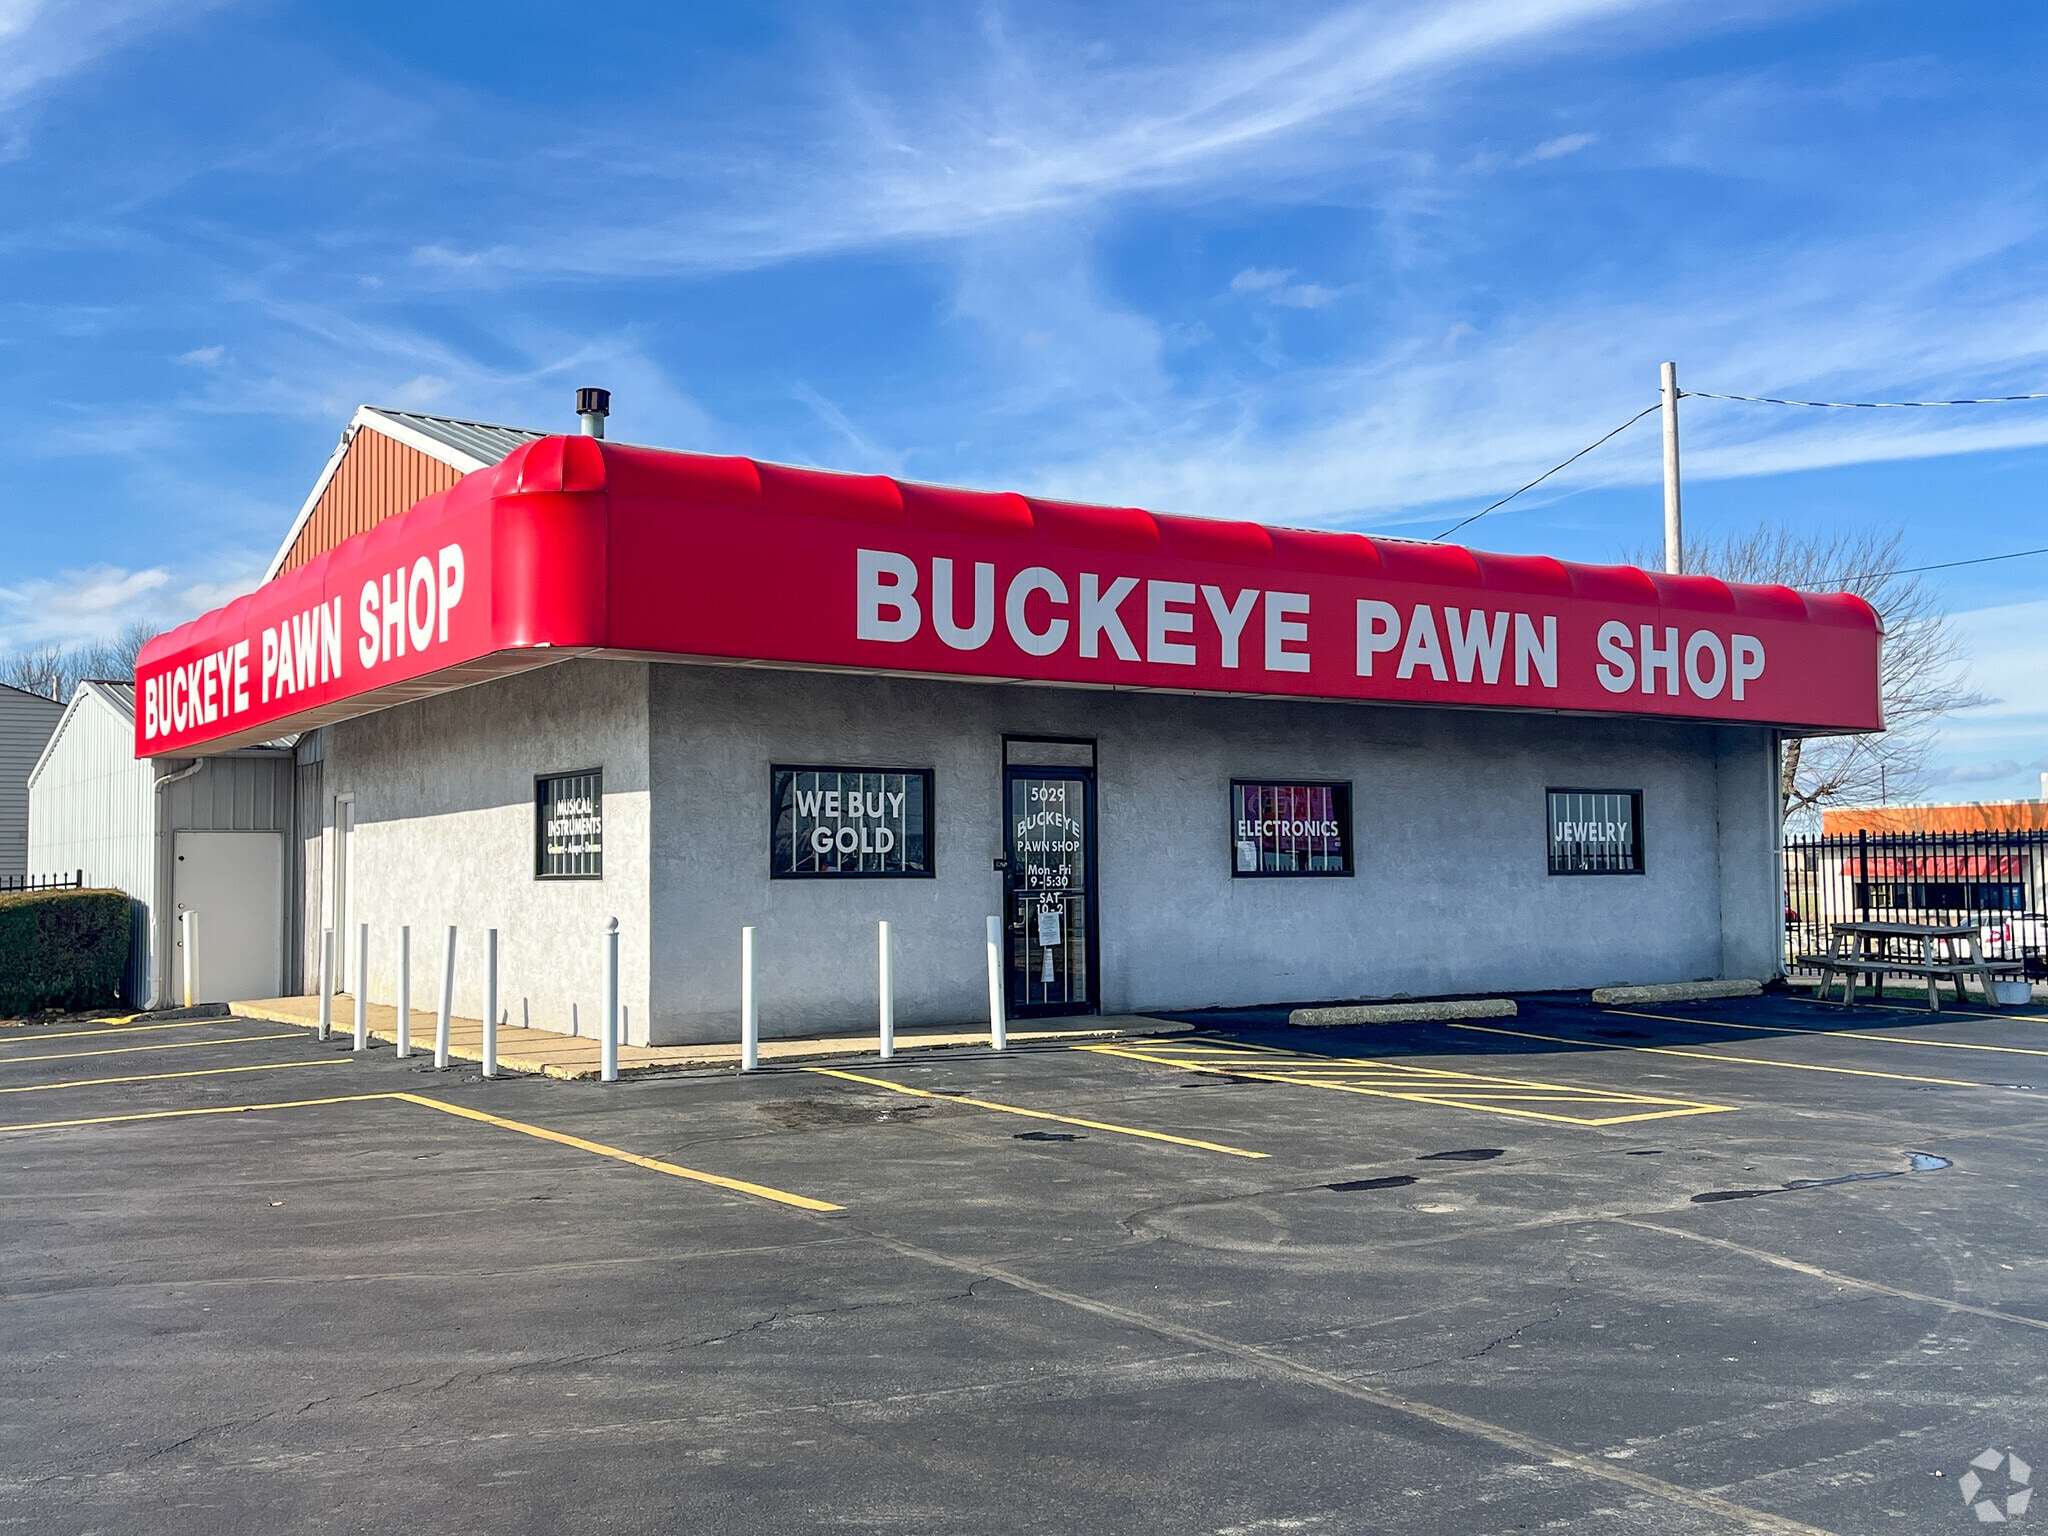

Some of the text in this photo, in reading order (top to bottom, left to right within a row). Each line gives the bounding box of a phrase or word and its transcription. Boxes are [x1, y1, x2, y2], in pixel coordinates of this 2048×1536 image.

[857, 548, 1766, 701] BUCKEYE PAWN SHOP
[145, 543, 465, 740] BUCKEYE PAWN SHOP
[1030, 787, 1066, 802] 5029
[557, 797, 592, 816] MUSICAL
[796, 791, 905, 818] WE BUY
[547, 817, 602, 837] INSTRUMENTS
[1017, 811, 1080, 838] BUCKEYE
[1238, 820, 1338, 837] ELECTRONICS
[1555, 822, 1627, 842] JEWELRY
[810, 826, 895, 853] GOLD
[1017, 840, 1080, 852] PAWN SHOP
[1028, 864, 1050, 875] Mon
[1059, 864, 1072, 875] Fri
[1030, 876, 1038, 887] 9
[1046, 876, 1069, 887] 5:30
[1040, 892, 1060, 904] SAT
[1056, 904, 1064, 914] 2
